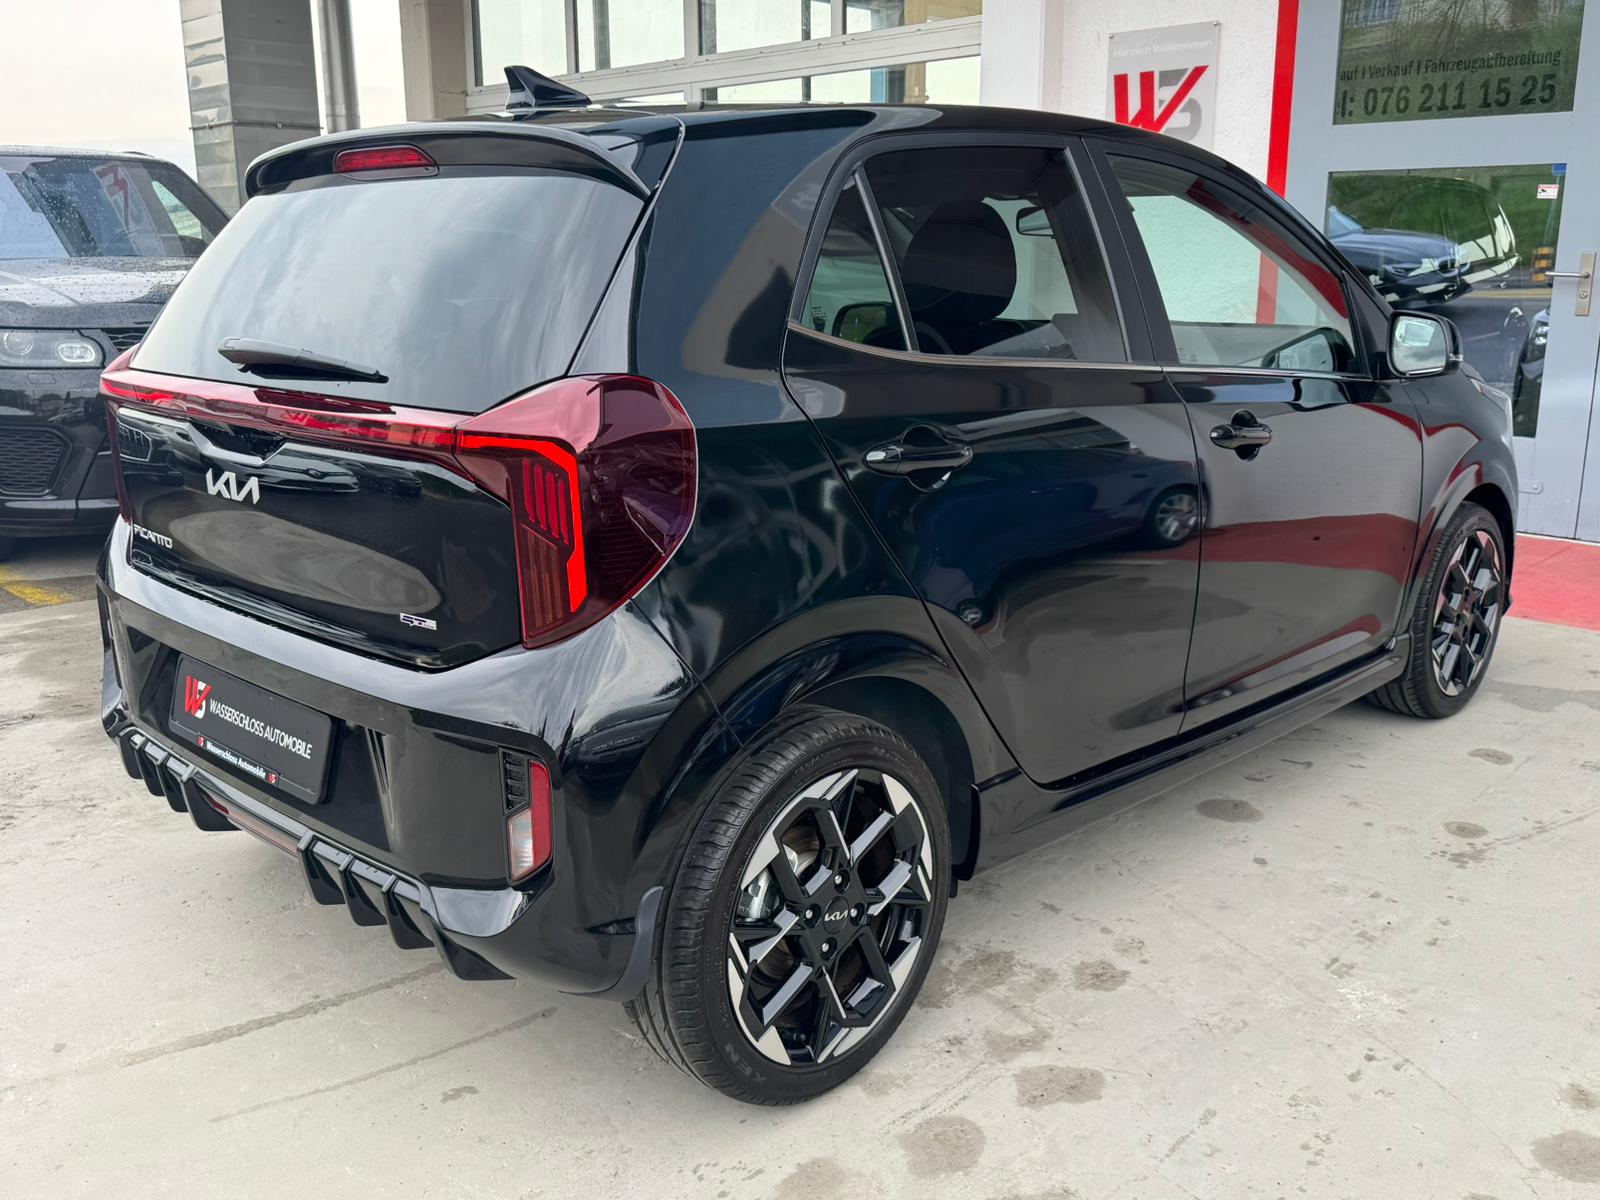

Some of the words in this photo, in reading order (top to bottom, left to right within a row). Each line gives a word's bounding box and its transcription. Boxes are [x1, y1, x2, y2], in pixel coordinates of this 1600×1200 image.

[1369, 61, 1414, 78] Verkauf
[1424, 49, 1561, 74] Fahrzeugaufbereitung
[1363, 84, 1411, 116] 076
[1418, 81, 1466, 112] 211
[1478, 77, 1512, 108] 15
[1520, 73, 1557, 105] 25
[205, 467, 260, 505] KIA
[209, 698, 265, 737] WASSERSCHLOSS
[263, 725, 313, 760] AUTOMOBILE
[206, 740, 238, 765] Wasserschloss
[238, 757, 266, 779] Automobile
[824, 909, 849, 922] KIA
